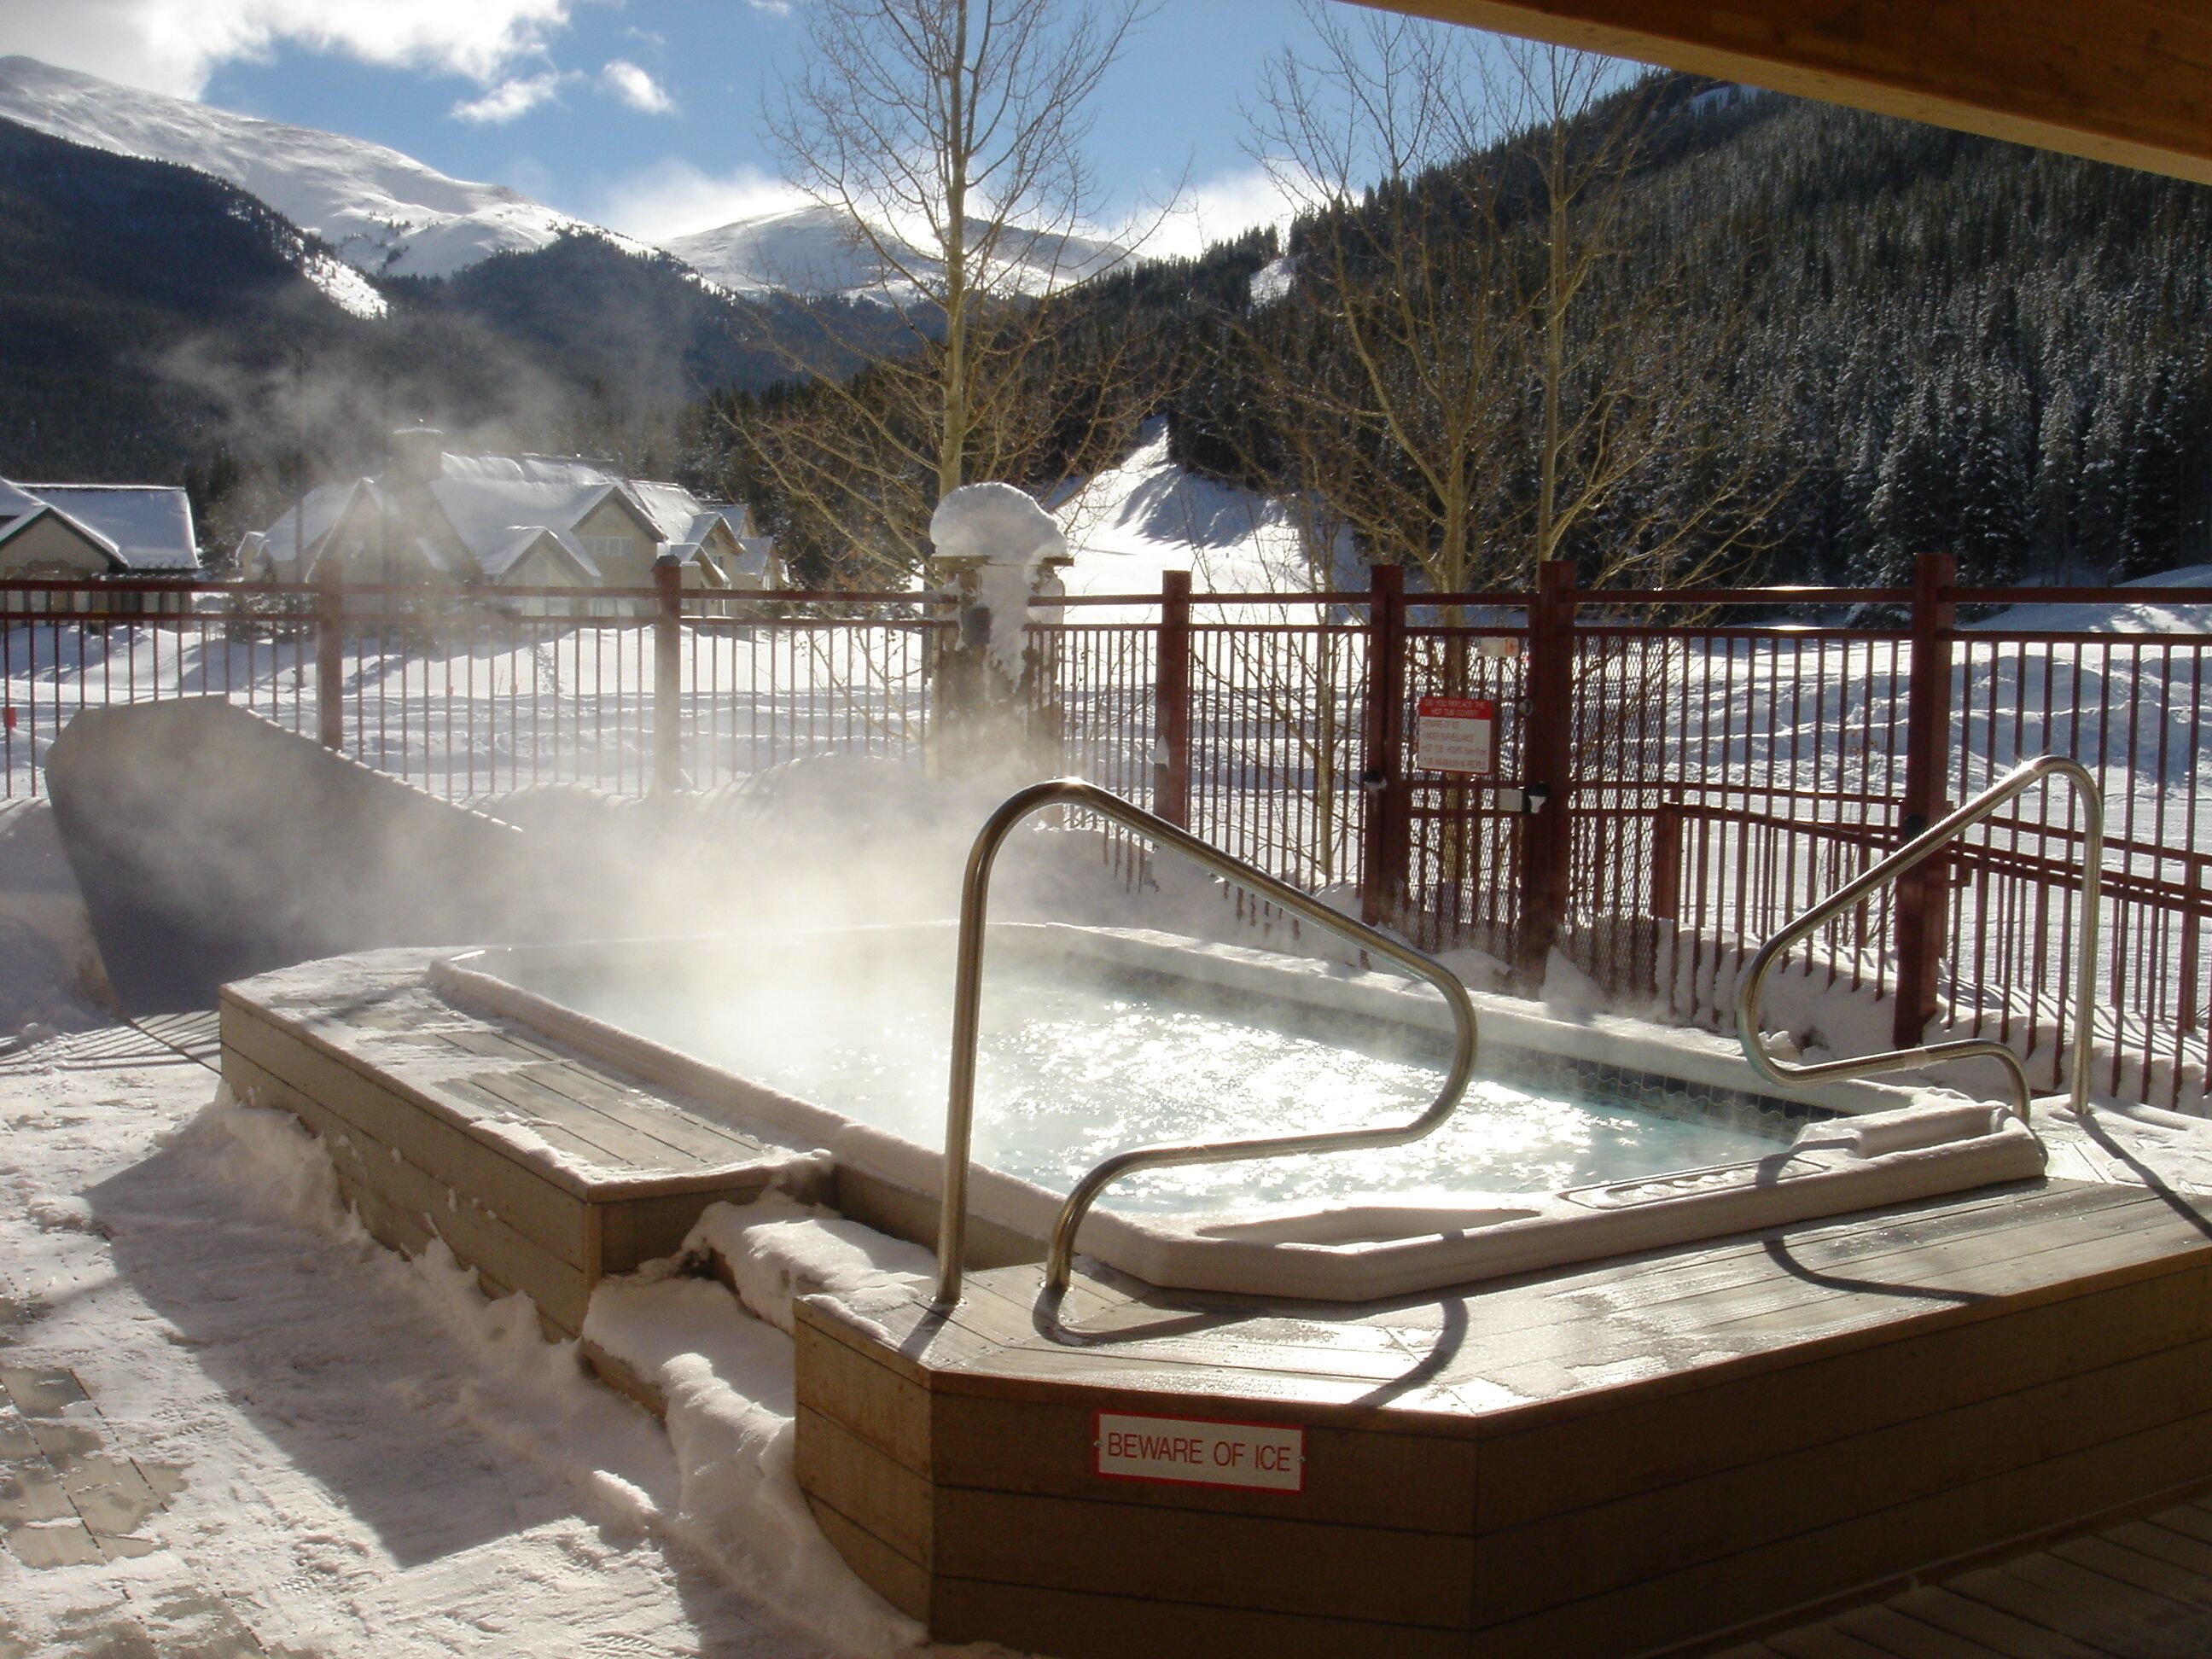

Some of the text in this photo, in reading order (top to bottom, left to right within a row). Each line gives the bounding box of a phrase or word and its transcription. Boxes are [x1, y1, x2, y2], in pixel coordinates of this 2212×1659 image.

[1108, 1432, 1290, 1472] BEWARE OF ICE
